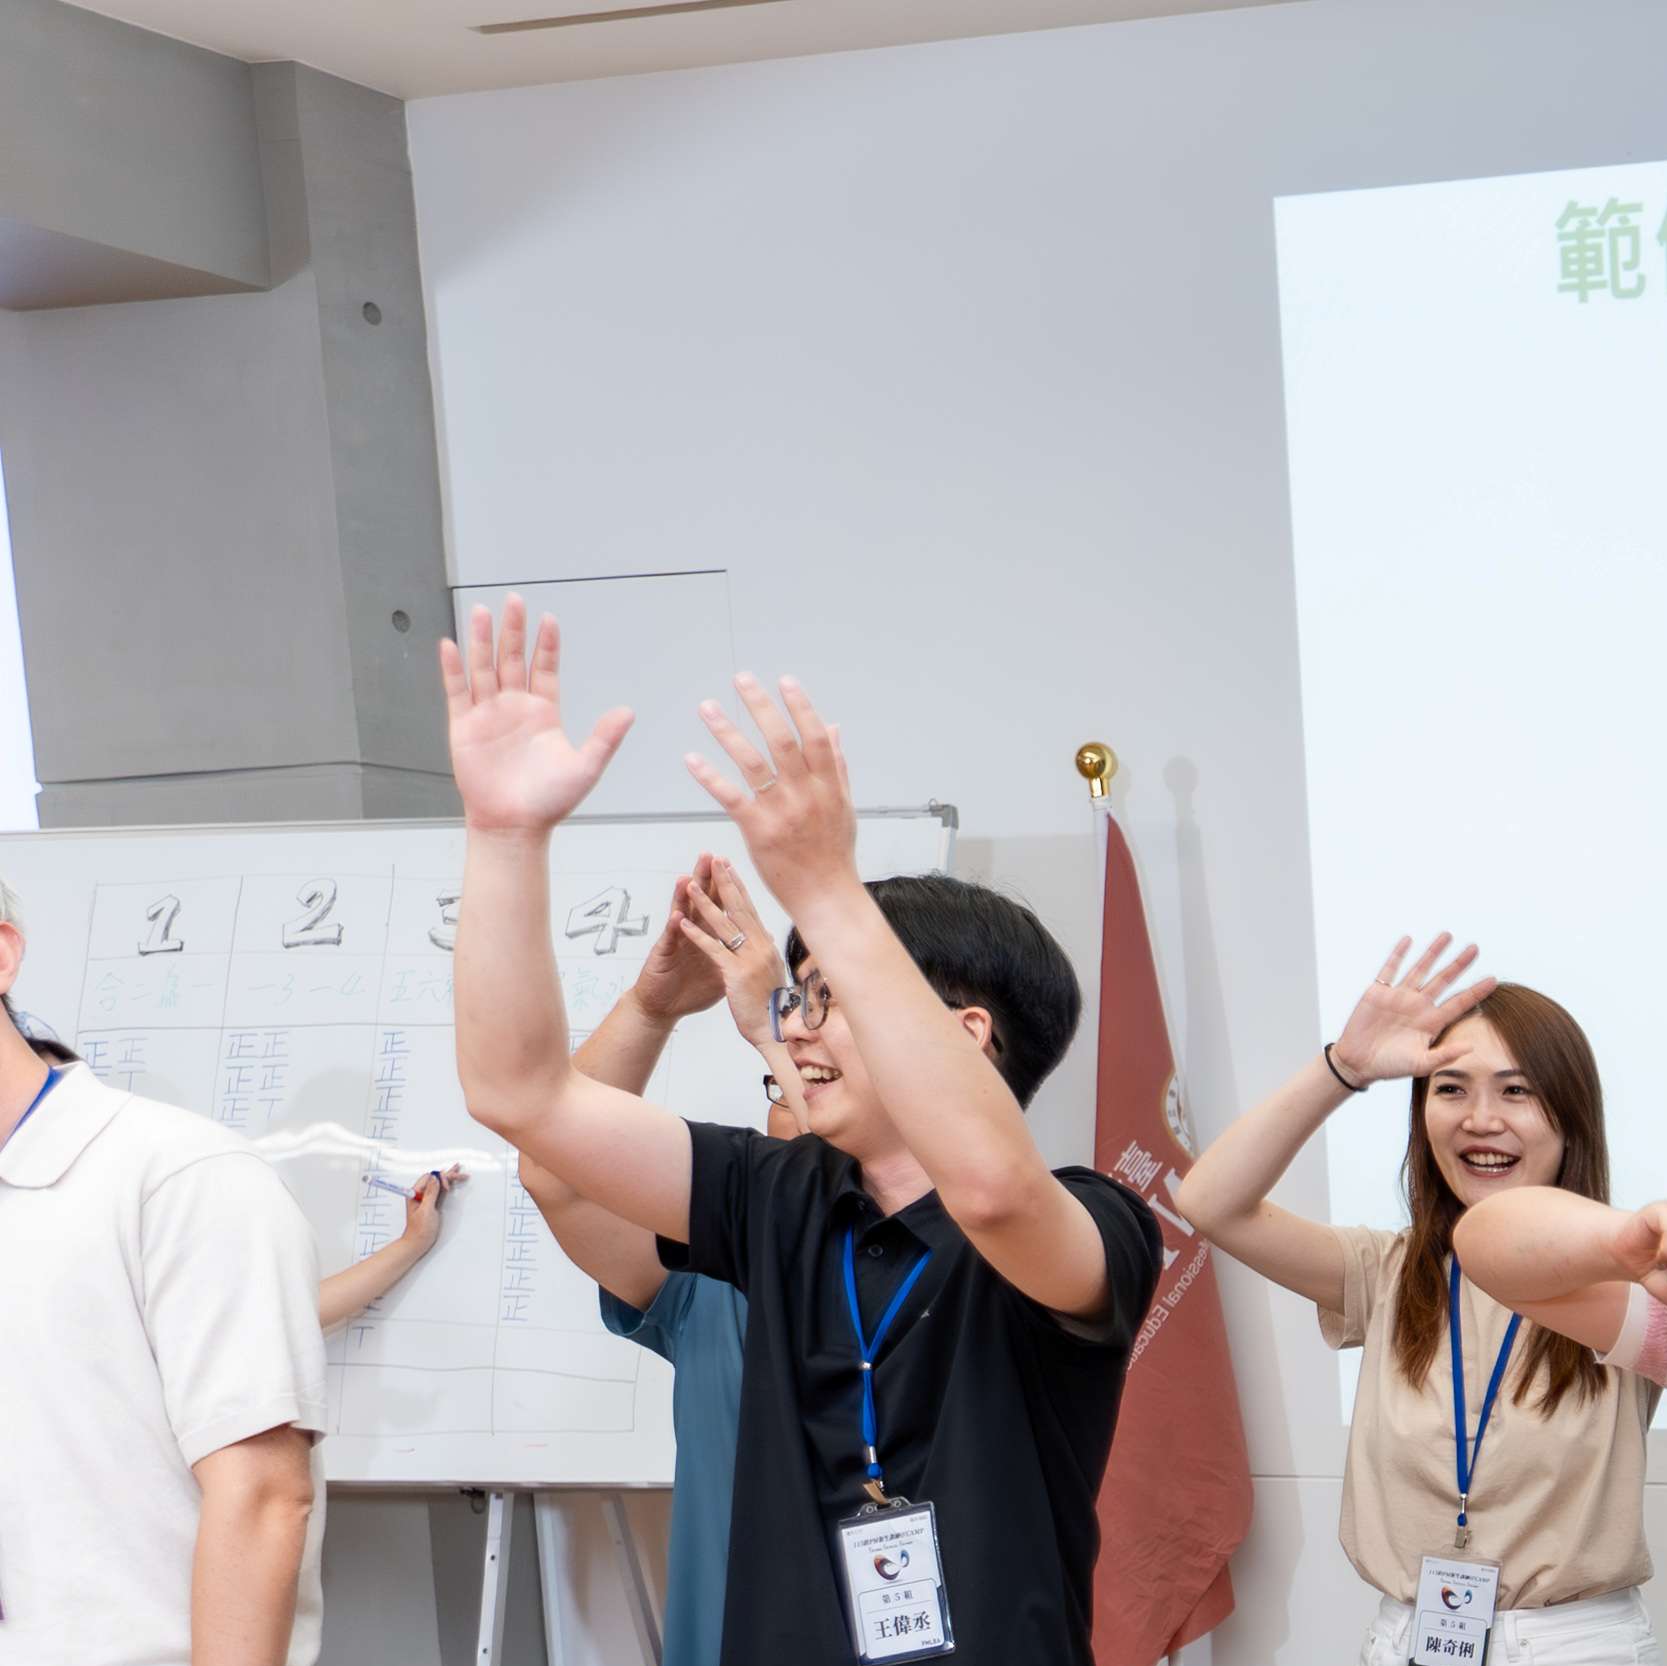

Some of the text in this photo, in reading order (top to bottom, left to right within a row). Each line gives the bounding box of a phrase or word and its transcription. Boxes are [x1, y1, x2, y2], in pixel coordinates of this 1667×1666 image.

[138, 894, 184, 956] 1
[282, 878, 344, 949] 2
[565, 886, 649, 956] 4
